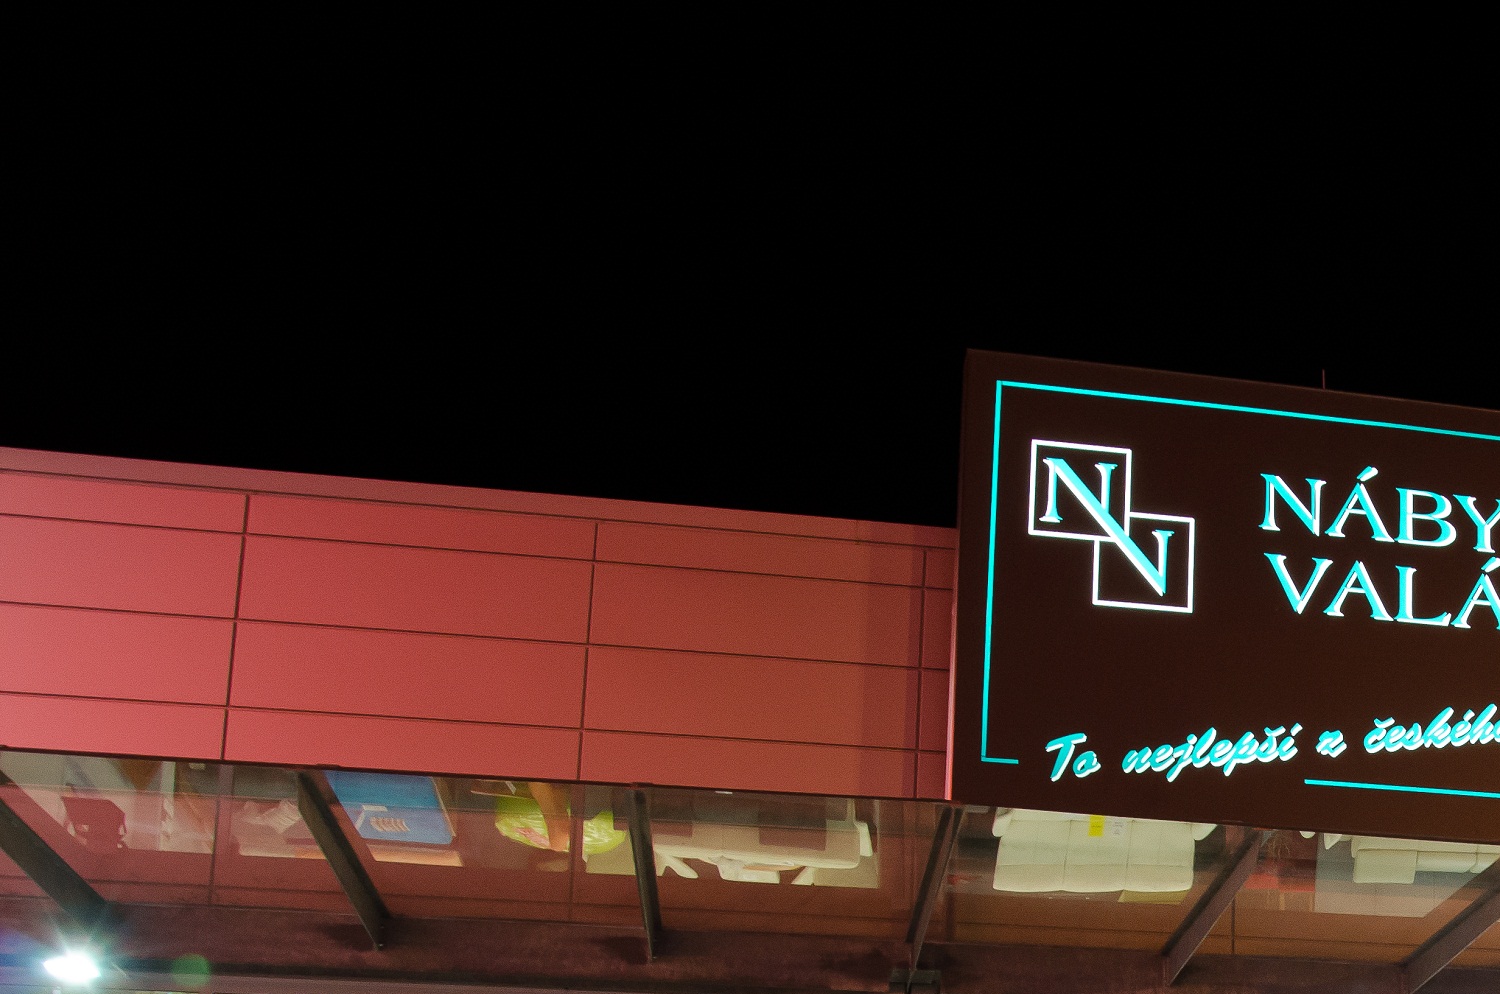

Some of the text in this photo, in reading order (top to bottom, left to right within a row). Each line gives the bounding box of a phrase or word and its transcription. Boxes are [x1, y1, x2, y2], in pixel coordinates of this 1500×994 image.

[1045, 732, 1101, 782] To
[1122, 722, 1304, 782] nejlepší
[1316, 728, 1347, 756] z
